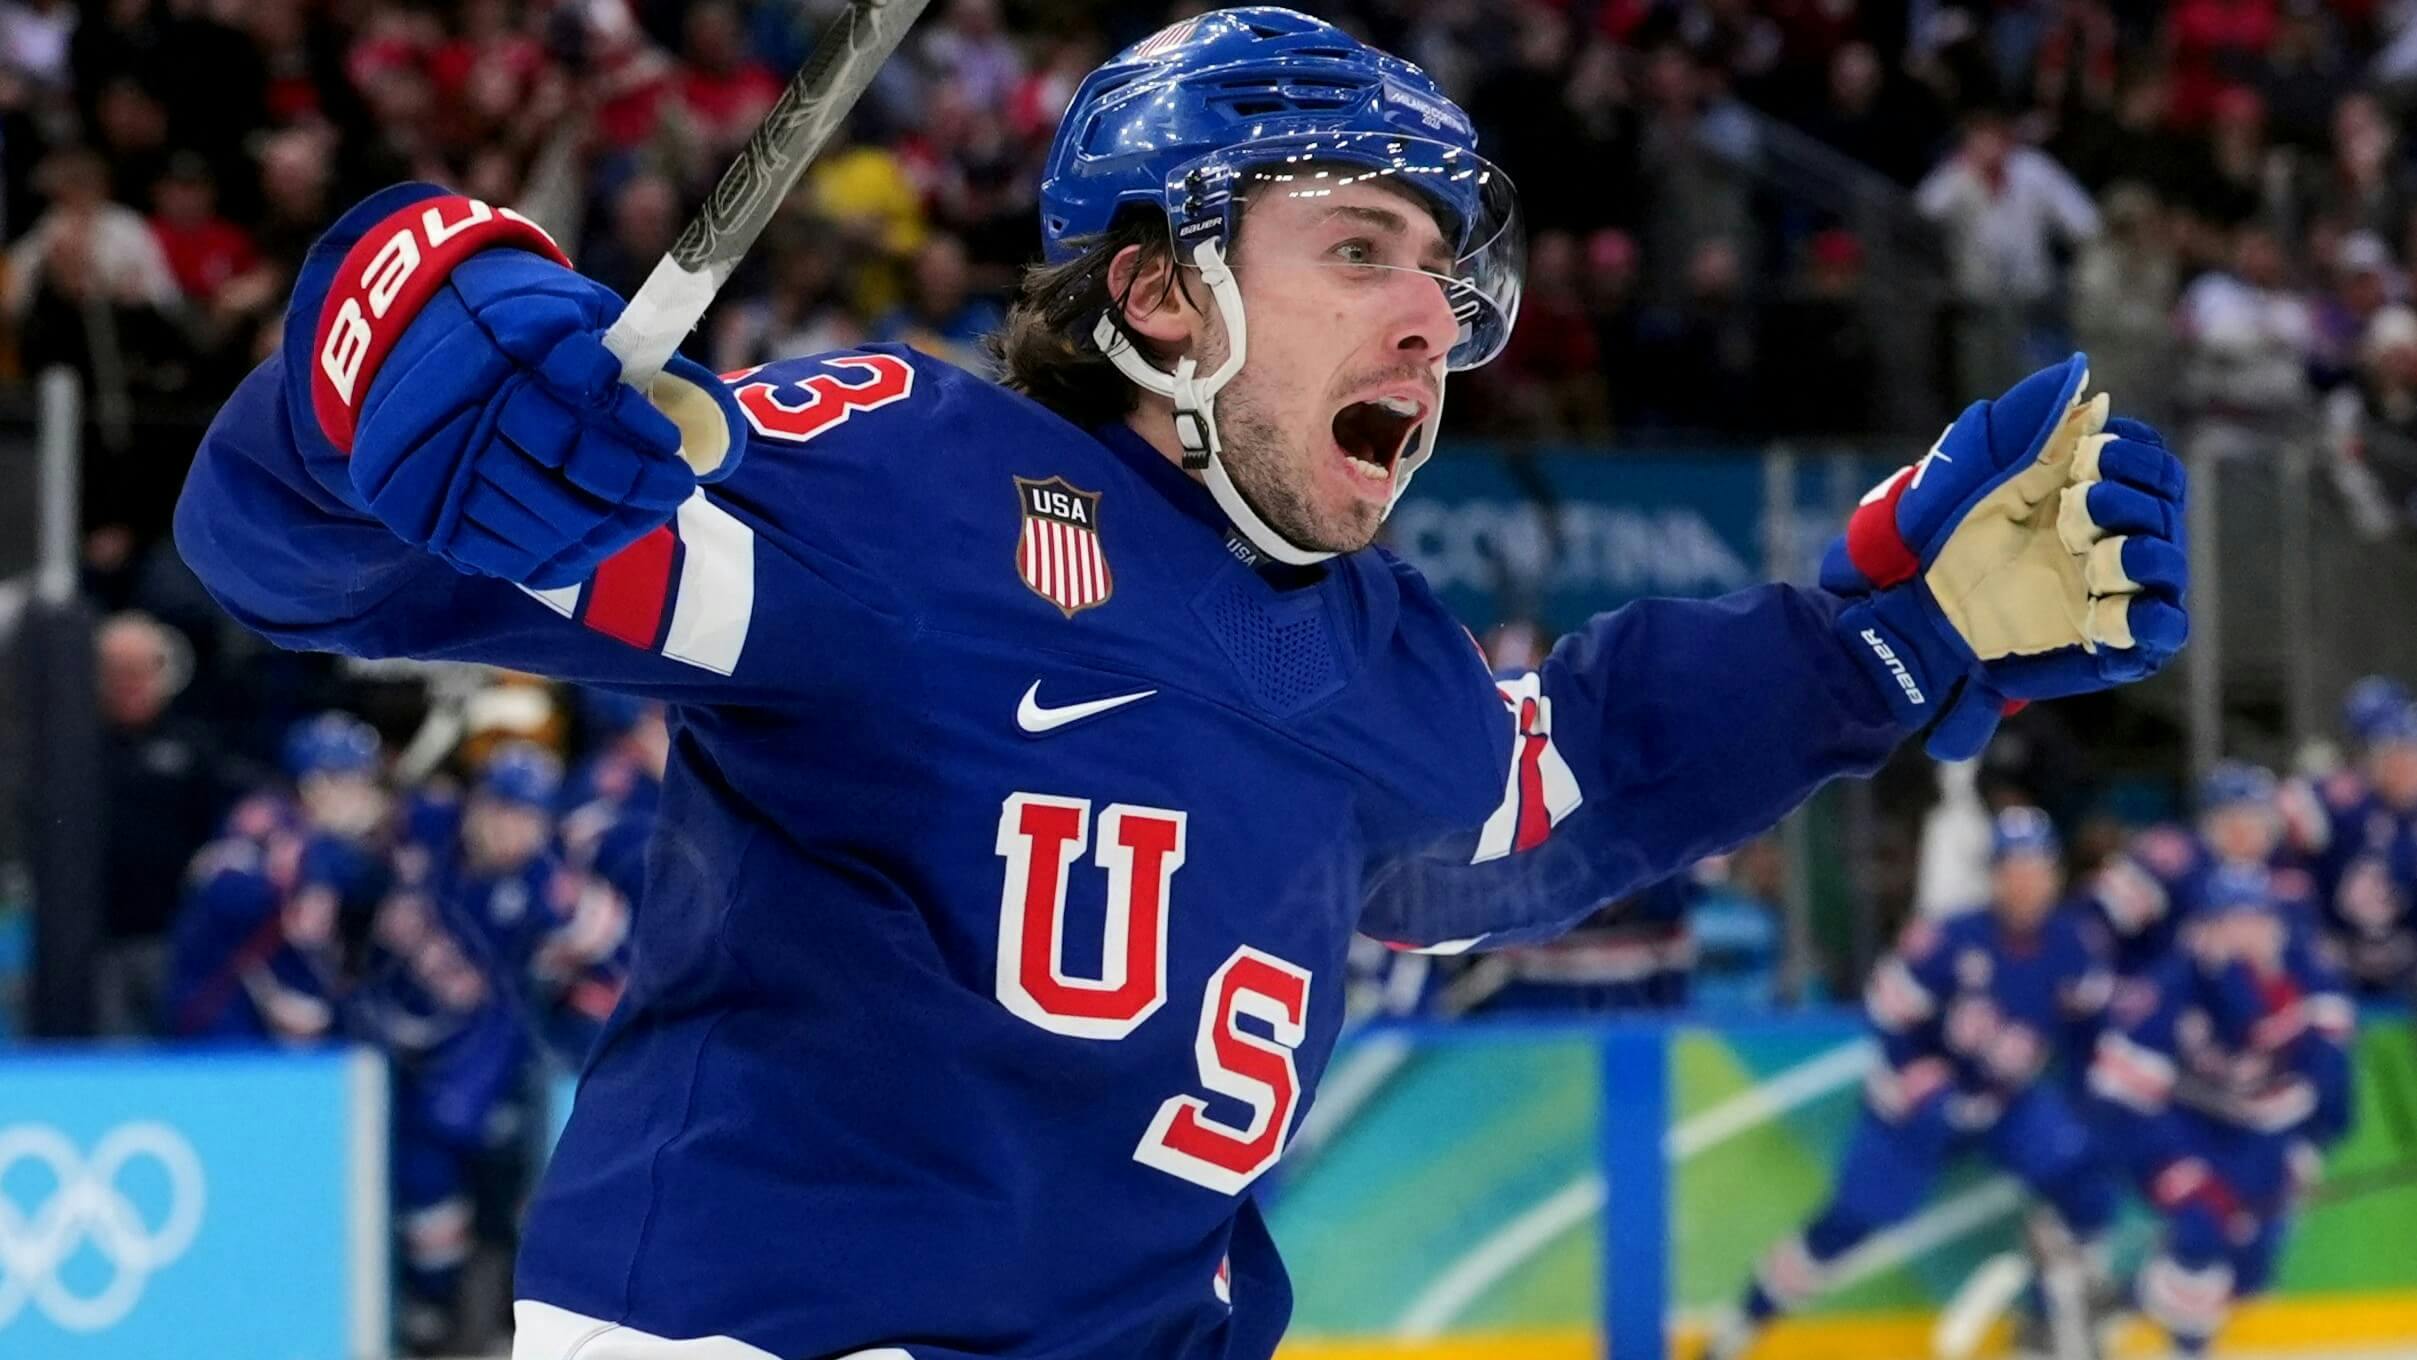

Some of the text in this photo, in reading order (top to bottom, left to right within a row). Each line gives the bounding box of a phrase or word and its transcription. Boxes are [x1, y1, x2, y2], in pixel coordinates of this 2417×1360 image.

[717, 353, 914, 442] 3
[1032, 488, 1087, 523] USA
[1226, 538, 1257, 567] USA
